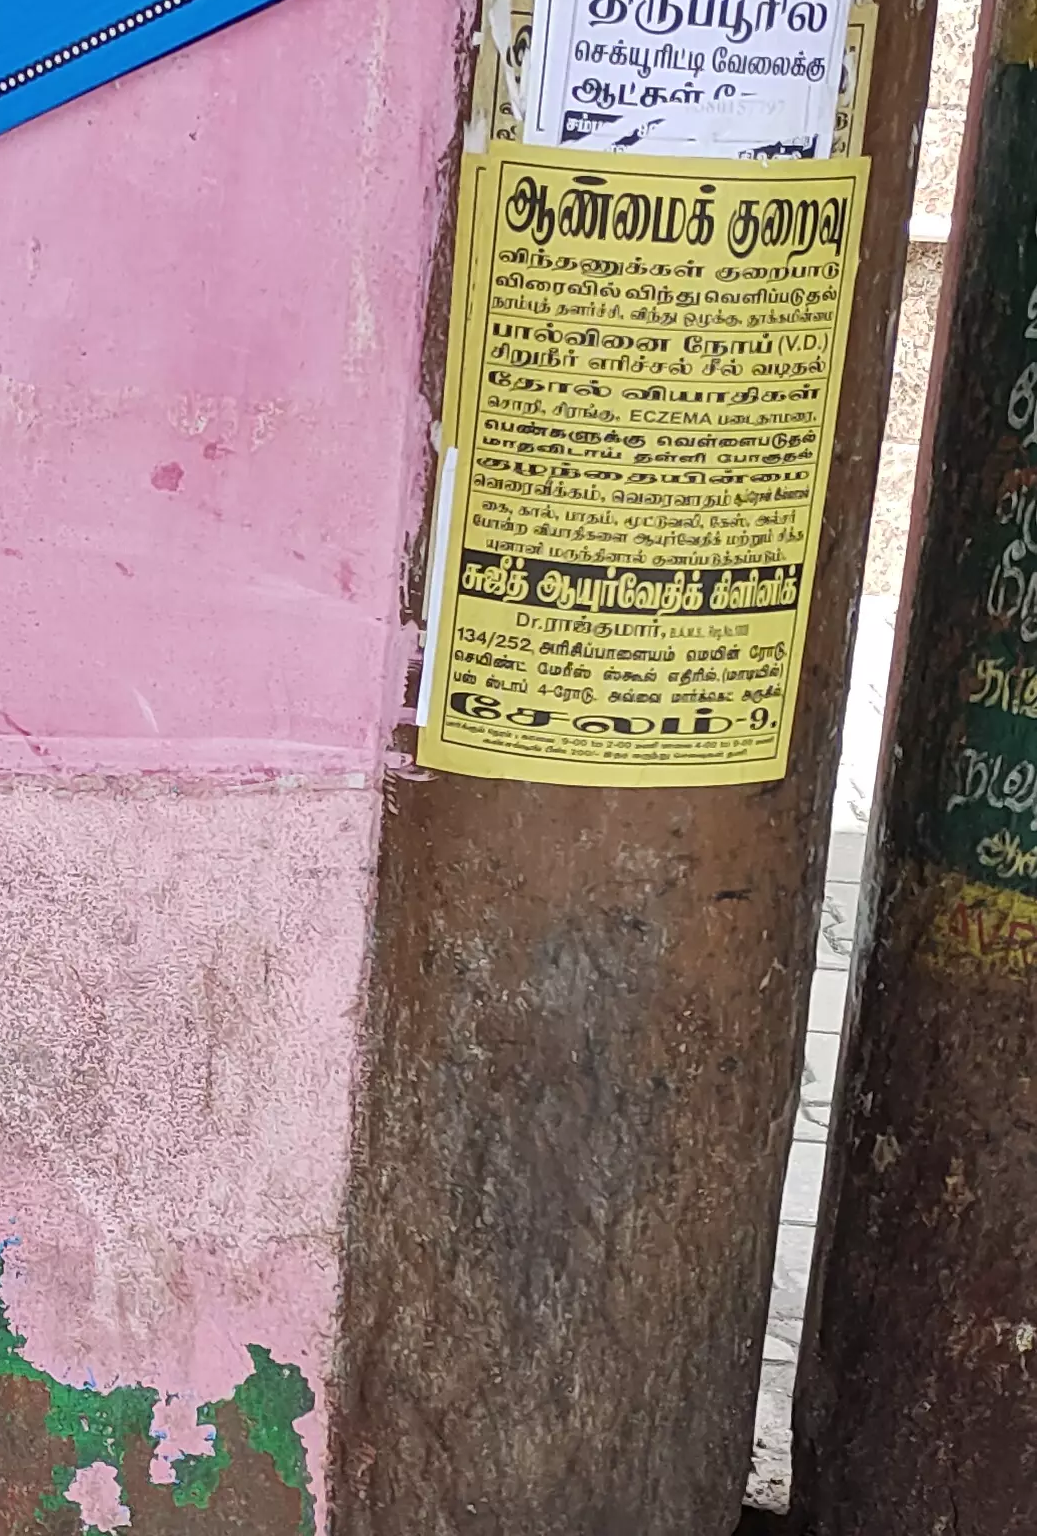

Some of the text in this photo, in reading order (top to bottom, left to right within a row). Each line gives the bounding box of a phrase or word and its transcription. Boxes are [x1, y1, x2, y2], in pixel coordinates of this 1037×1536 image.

[575, 40, 825, 82] செக்யூரிட்டி வேலைக்கு
[506, 175, 848, 267] ஆண்மைக் குறைவு
[499, 248, 840, 283] விந்தணுக்கள் குறைபாடு
[495, 273, 837, 307] விரைவில் விந்து வெளிப்படுதல்
[492, 323, 828, 358] பால்வினை நோய் (V.D.)
[491, 343, 579, 368] சிறுநீர்
[588, 355, 693, 377] எரிச்சல்
[487, 371, 820, 406] தோல் வியாதிகள்
[484, 419, 646, 448] பெண்களுக்கு
[630, 410, 712, 426] ECZEMA
[482, 436, 622, 461] மாதவிடாய்
[476, 458, 810, 485] குழந்தையின்மை
[708, 565, 797, 609] கிளினிக்
